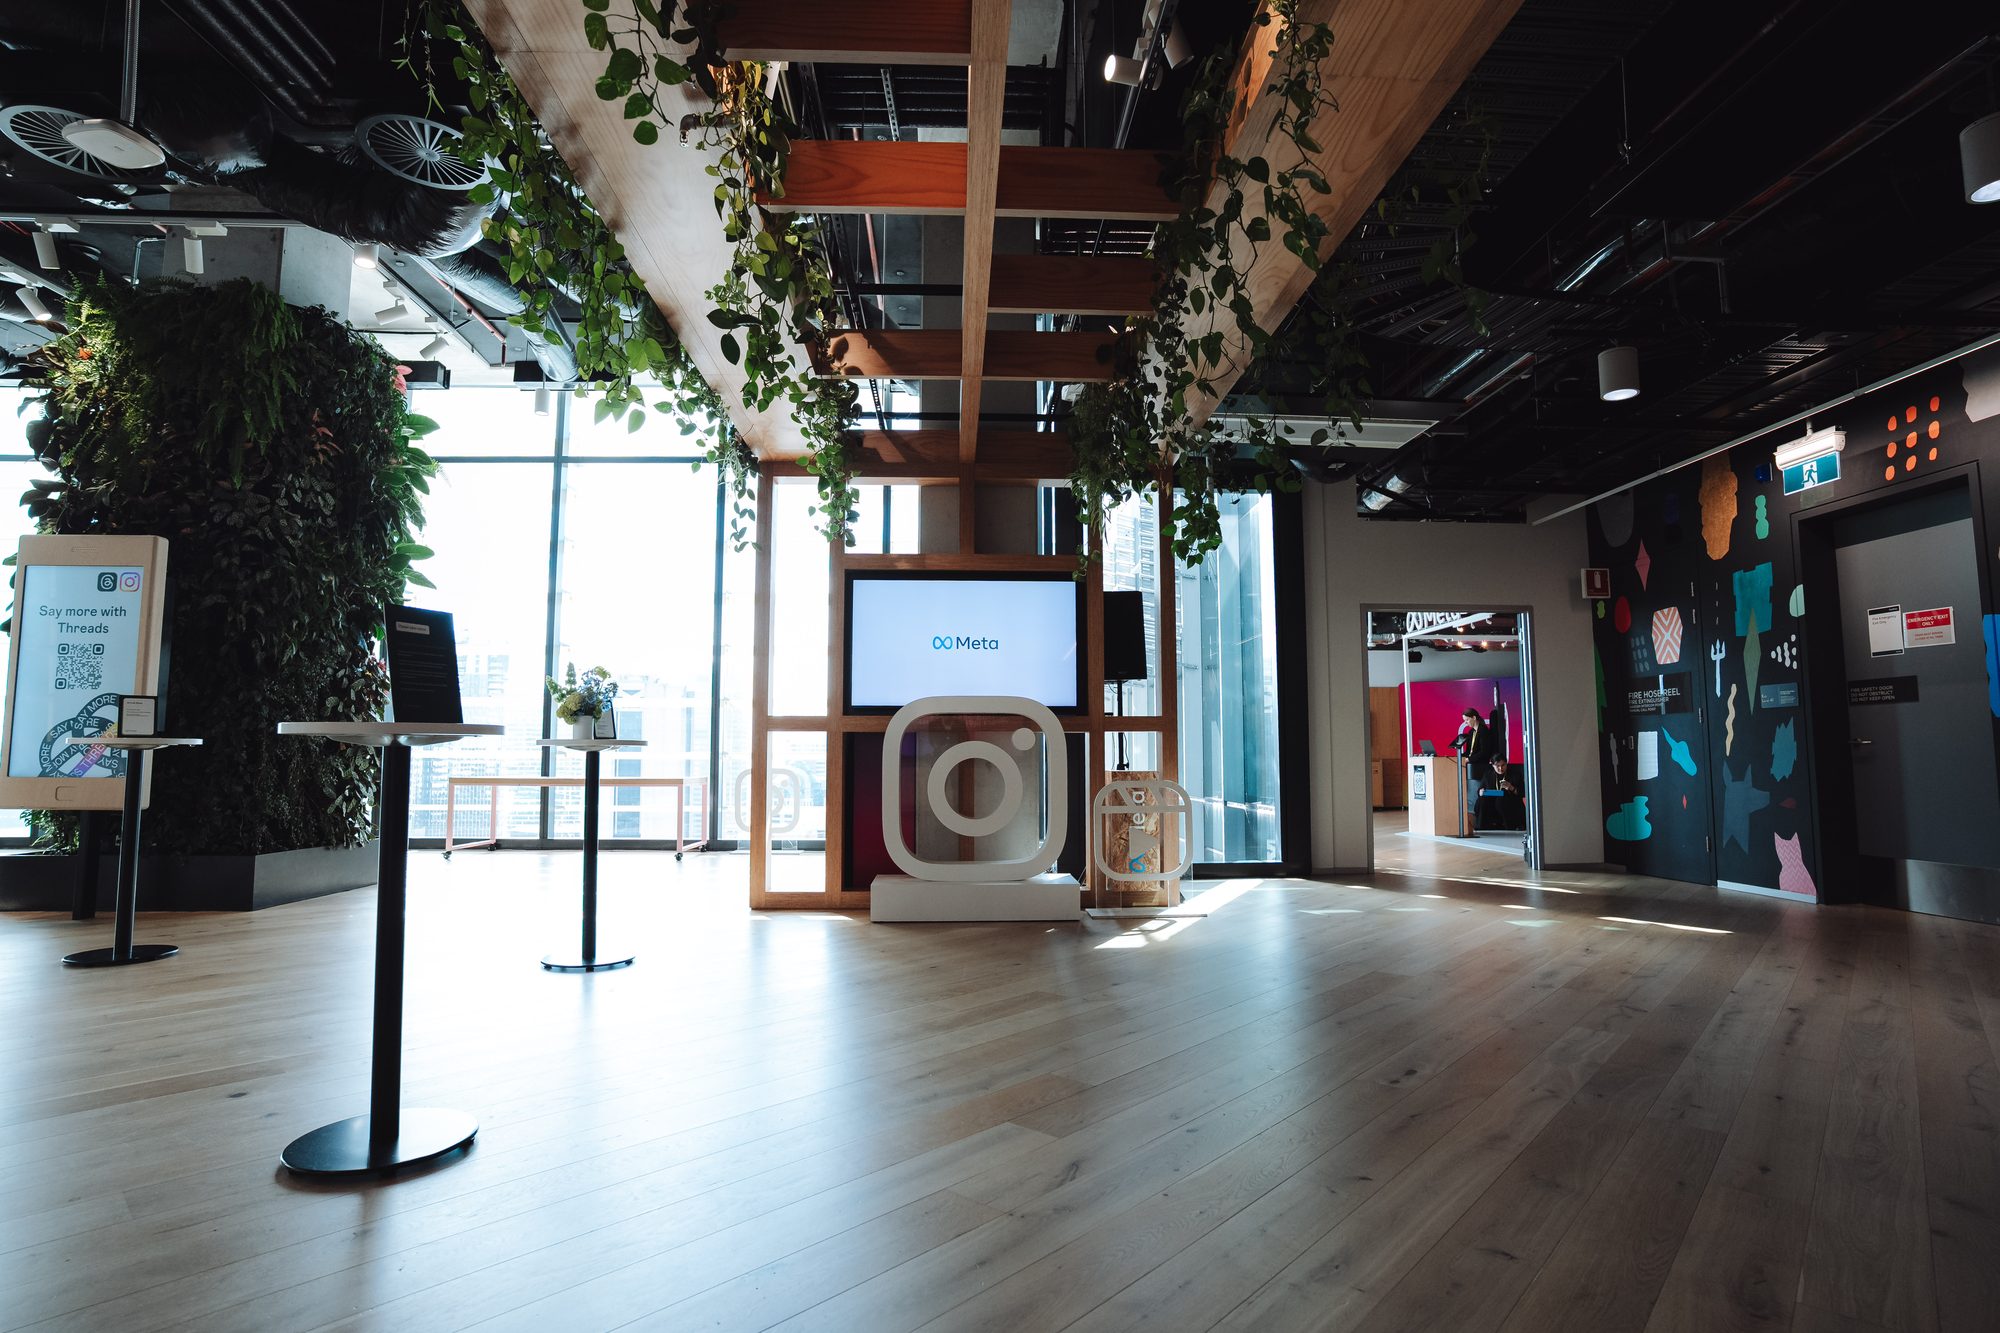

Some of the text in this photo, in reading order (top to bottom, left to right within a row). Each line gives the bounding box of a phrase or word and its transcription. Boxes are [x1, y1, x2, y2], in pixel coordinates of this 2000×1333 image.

[39, 605, 127, 619] Say more with
[57, 622, 110, 634] Threads
[956, 636, 999, 650] Meta
[1643, 690, 1661, 698] HOSE
[1662, 688, 1680, 696] REEL
[74, 709, 89, 730] SAY
[87, 695, 118, 713] MORE
[50, 722, 68, 739] SAY
